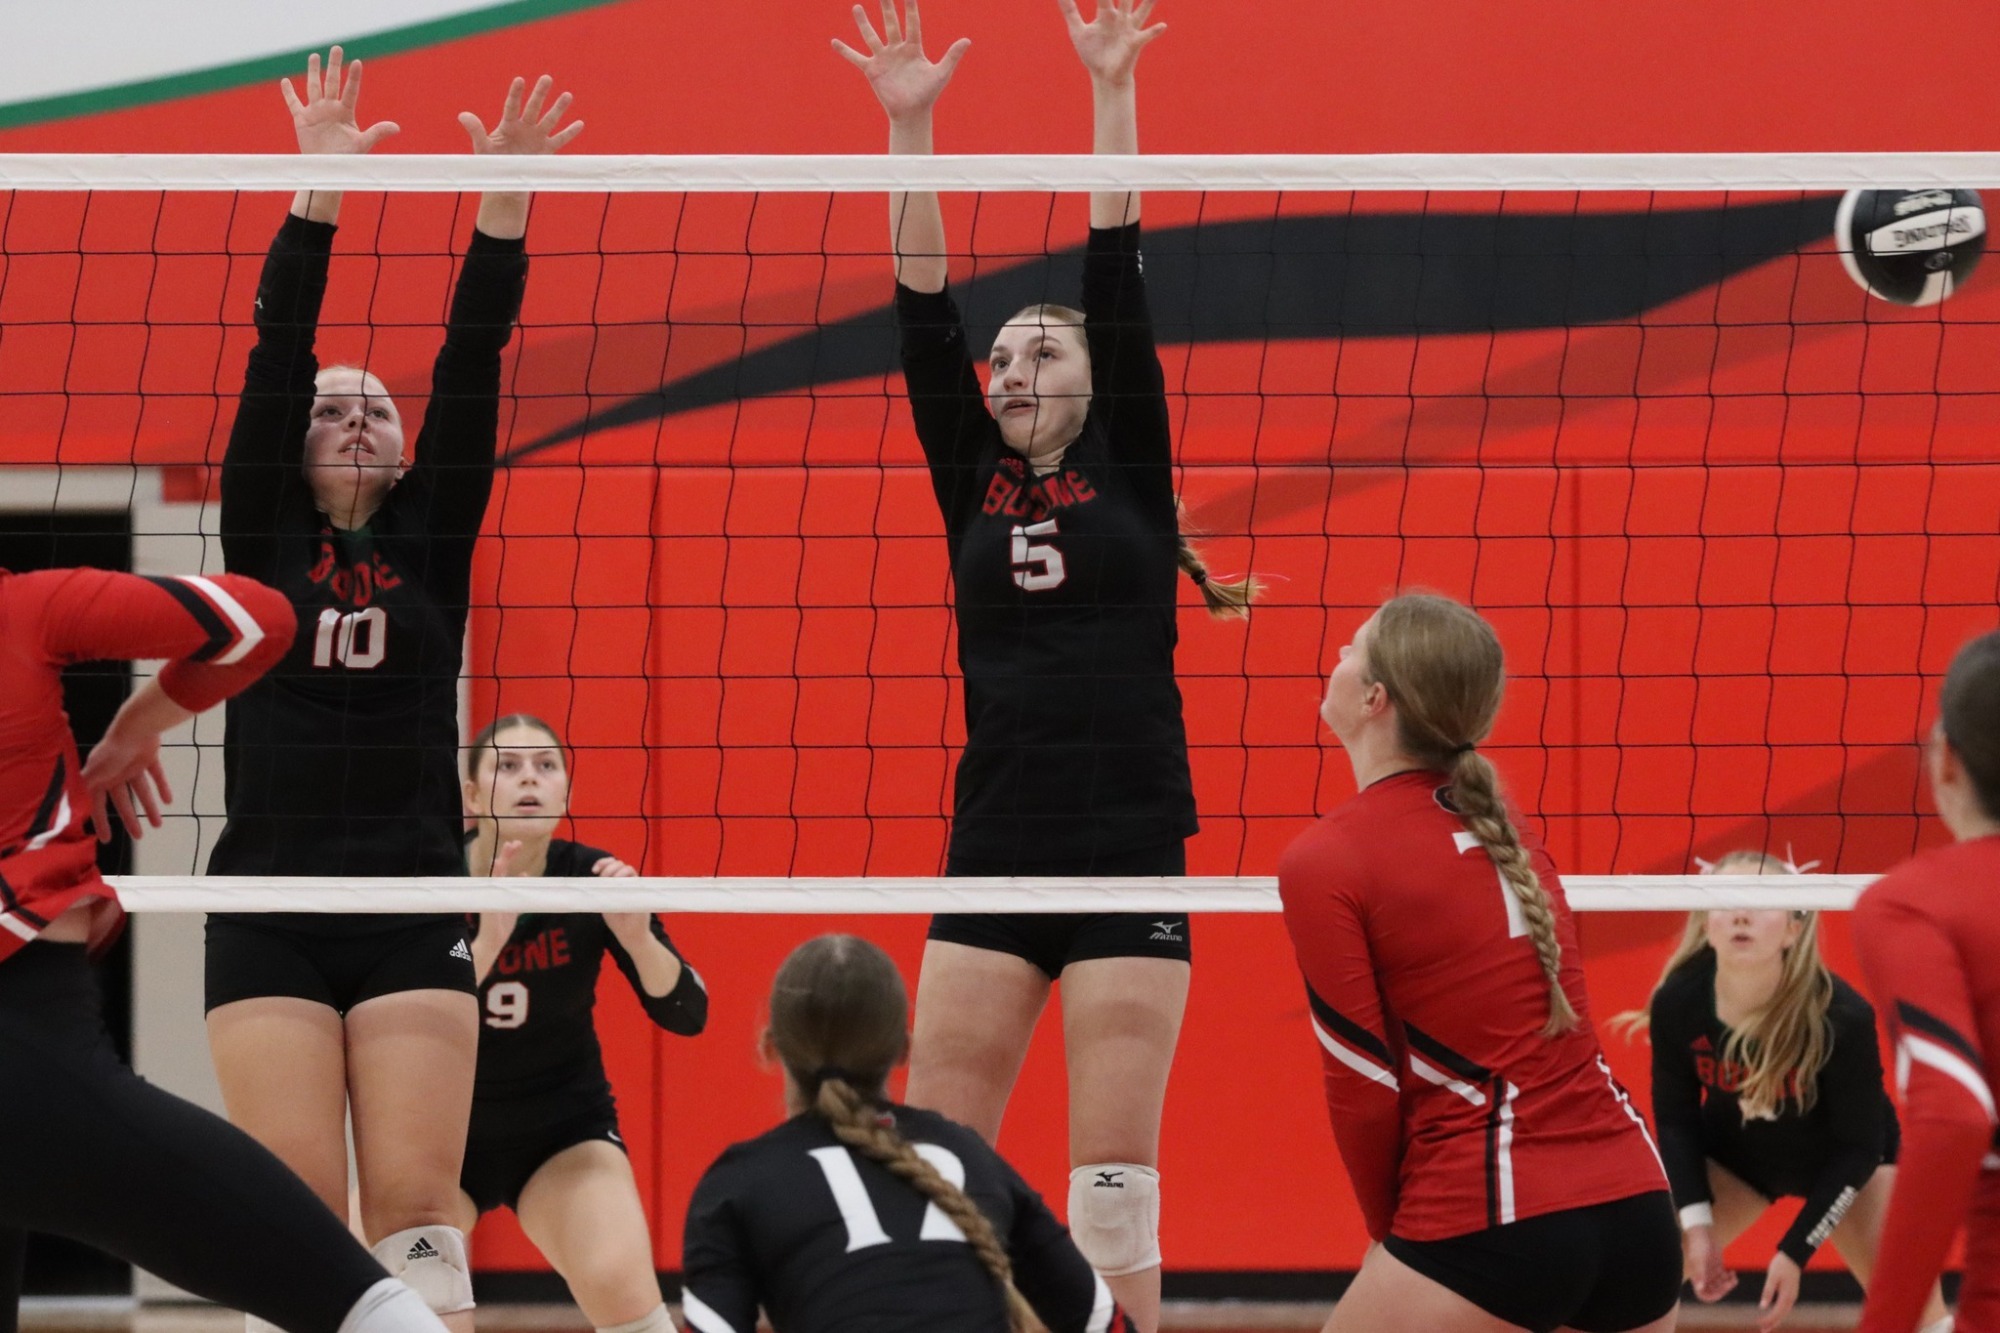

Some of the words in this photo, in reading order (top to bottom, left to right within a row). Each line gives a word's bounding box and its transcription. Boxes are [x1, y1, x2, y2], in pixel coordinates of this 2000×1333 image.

[1011, 516, 1068, 592] 5
[312, 606, 388, 670] 10
[497, 927, 571, 975] ONE
[485, 981, 530, 1029] 9
[406, 1248, 440, 1261] adidas
